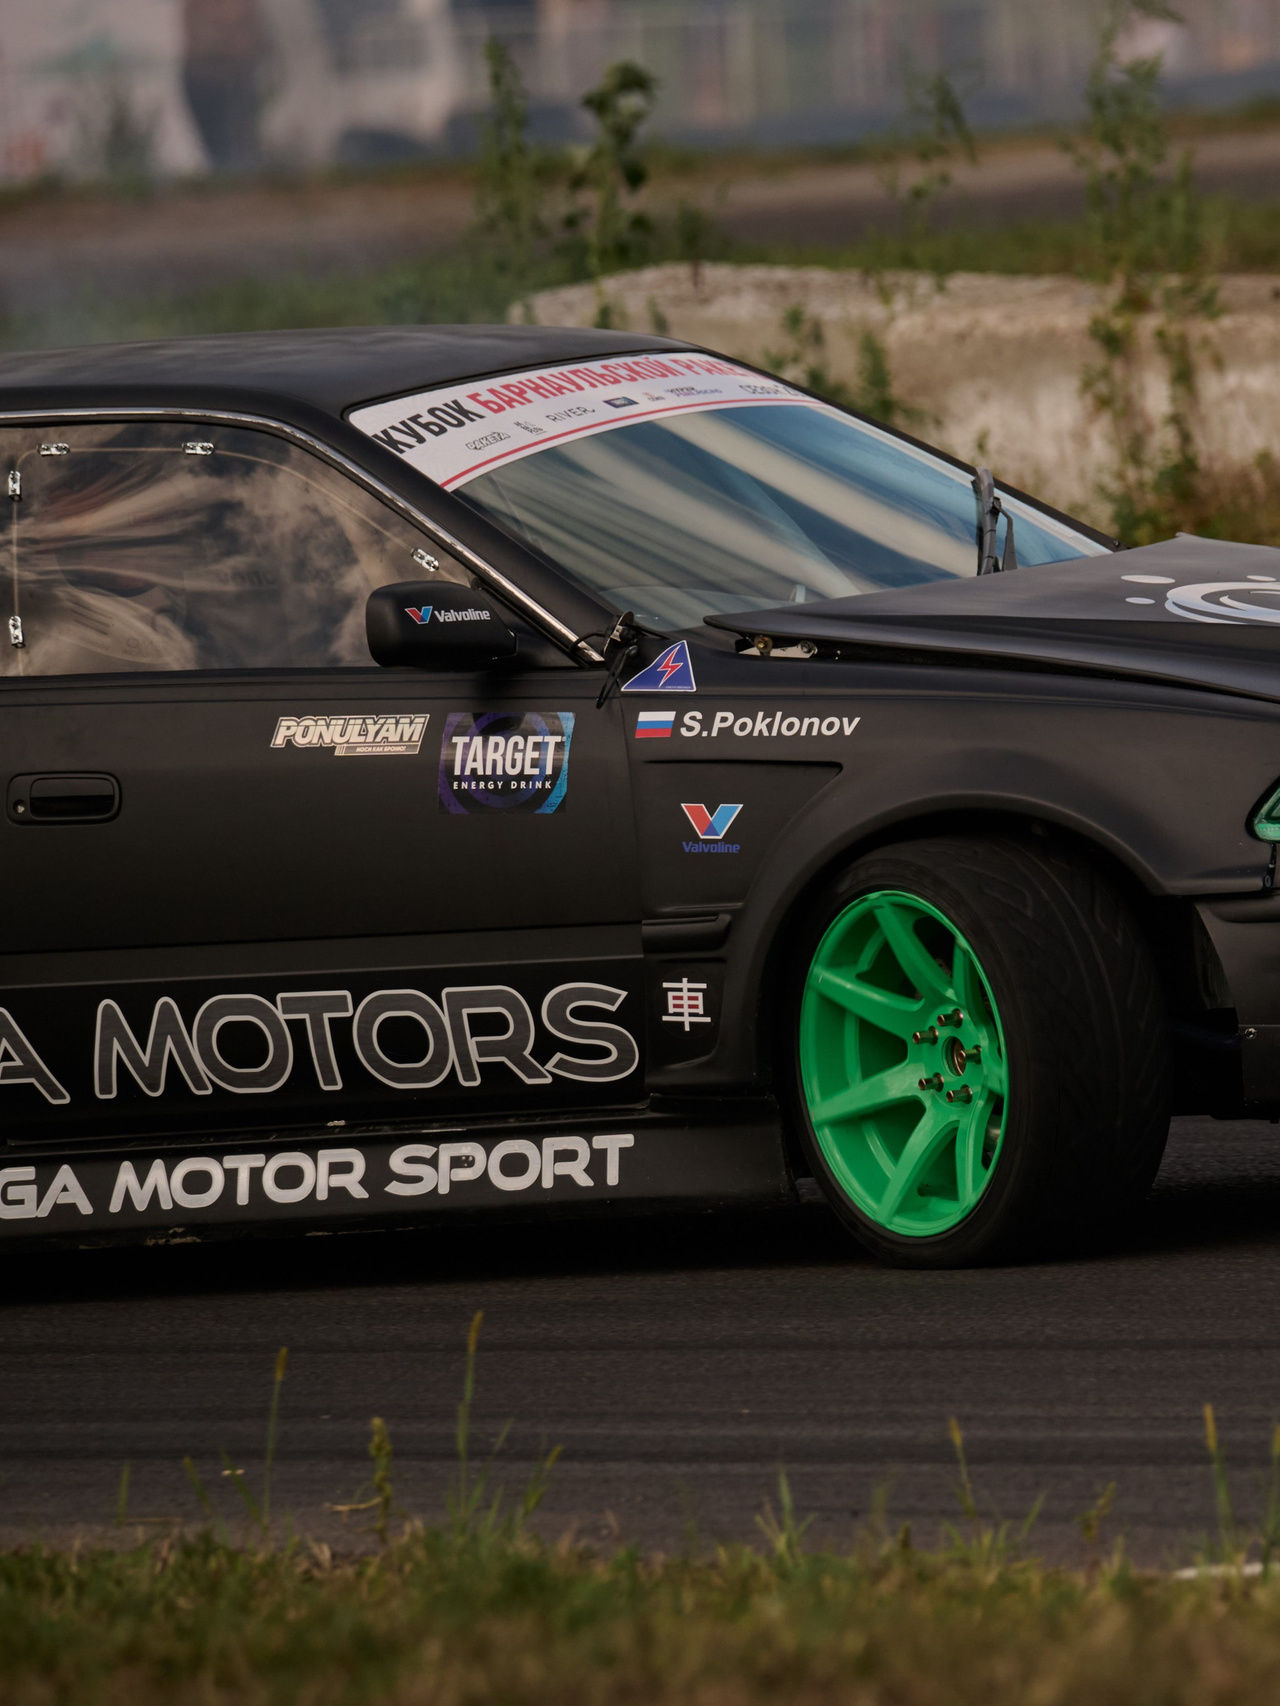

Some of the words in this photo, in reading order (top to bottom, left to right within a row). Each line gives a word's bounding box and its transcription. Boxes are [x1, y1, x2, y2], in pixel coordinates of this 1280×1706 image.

[372, 399, 486, 454] КУБОК
[466, 357, 686, 414] БАРНАУЛЬСКОЙ
[545, 406, 596, 423] RIVER
[434, 608, 491, 622] Valvoline
[271, 714, 429, 748] PONULYAM
[680, 711, 861, 737] S.Poklonov
[451, 735, 562, 776] TARGET
[453, 781, 504, 790] ENERGY
[510, 780, 553, 790] DRINK
[682, 841, 741, 853] Valvoline
[662, 977, 712, 1032] 車
[94, 982, 640, 1099] MOTORS
[109, 1148, 370, 1214] MOTOR
[384, 1134, 635, 1196] SPORT
